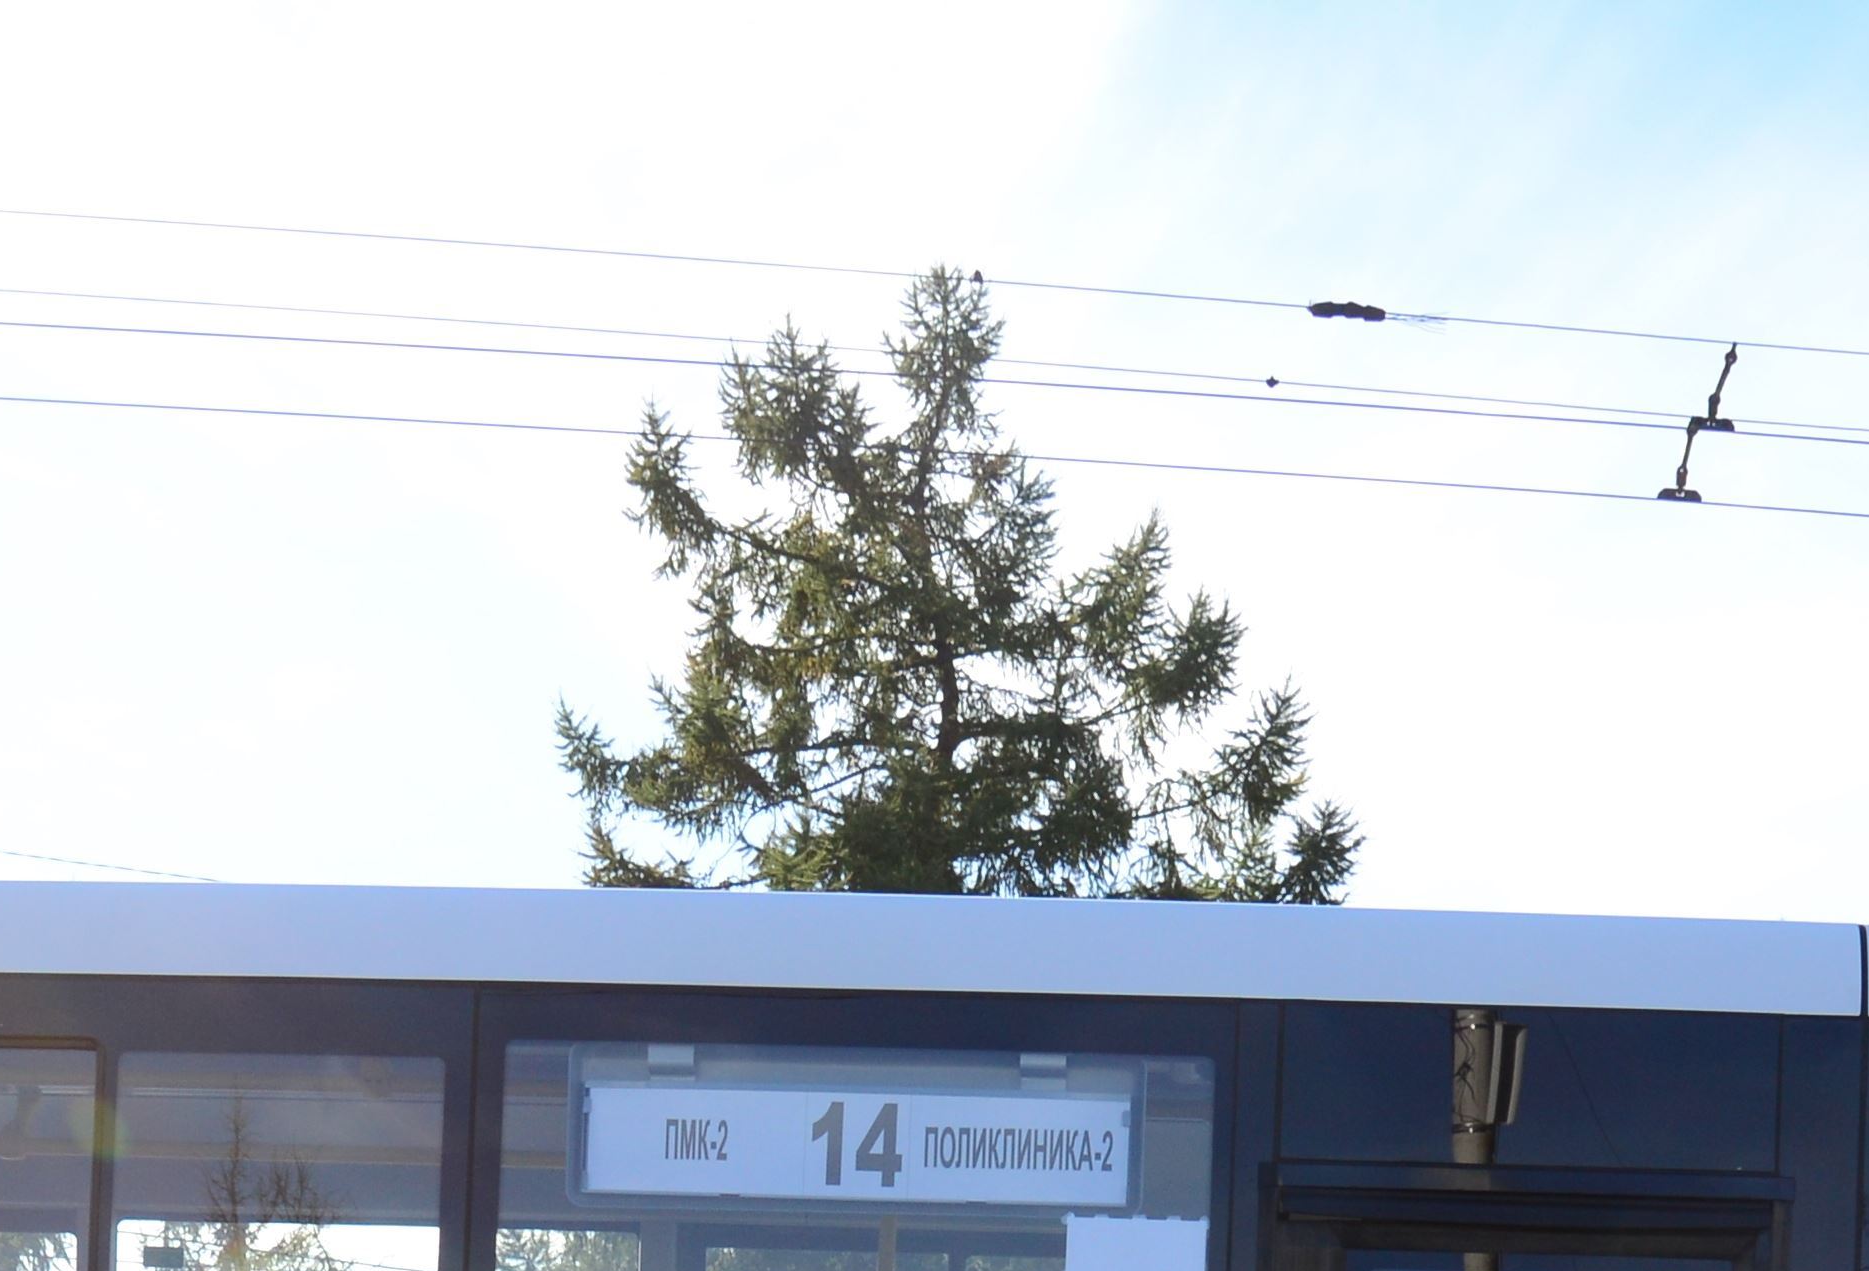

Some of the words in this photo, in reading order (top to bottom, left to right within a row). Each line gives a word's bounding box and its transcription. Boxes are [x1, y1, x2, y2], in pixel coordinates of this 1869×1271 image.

[664, 1118, 729, 1162] ПМК-2
[811, 1100, 903, 1188] 14
[923, 1125, 1114, 1172] ПОЛИКЛИНИКА-2
